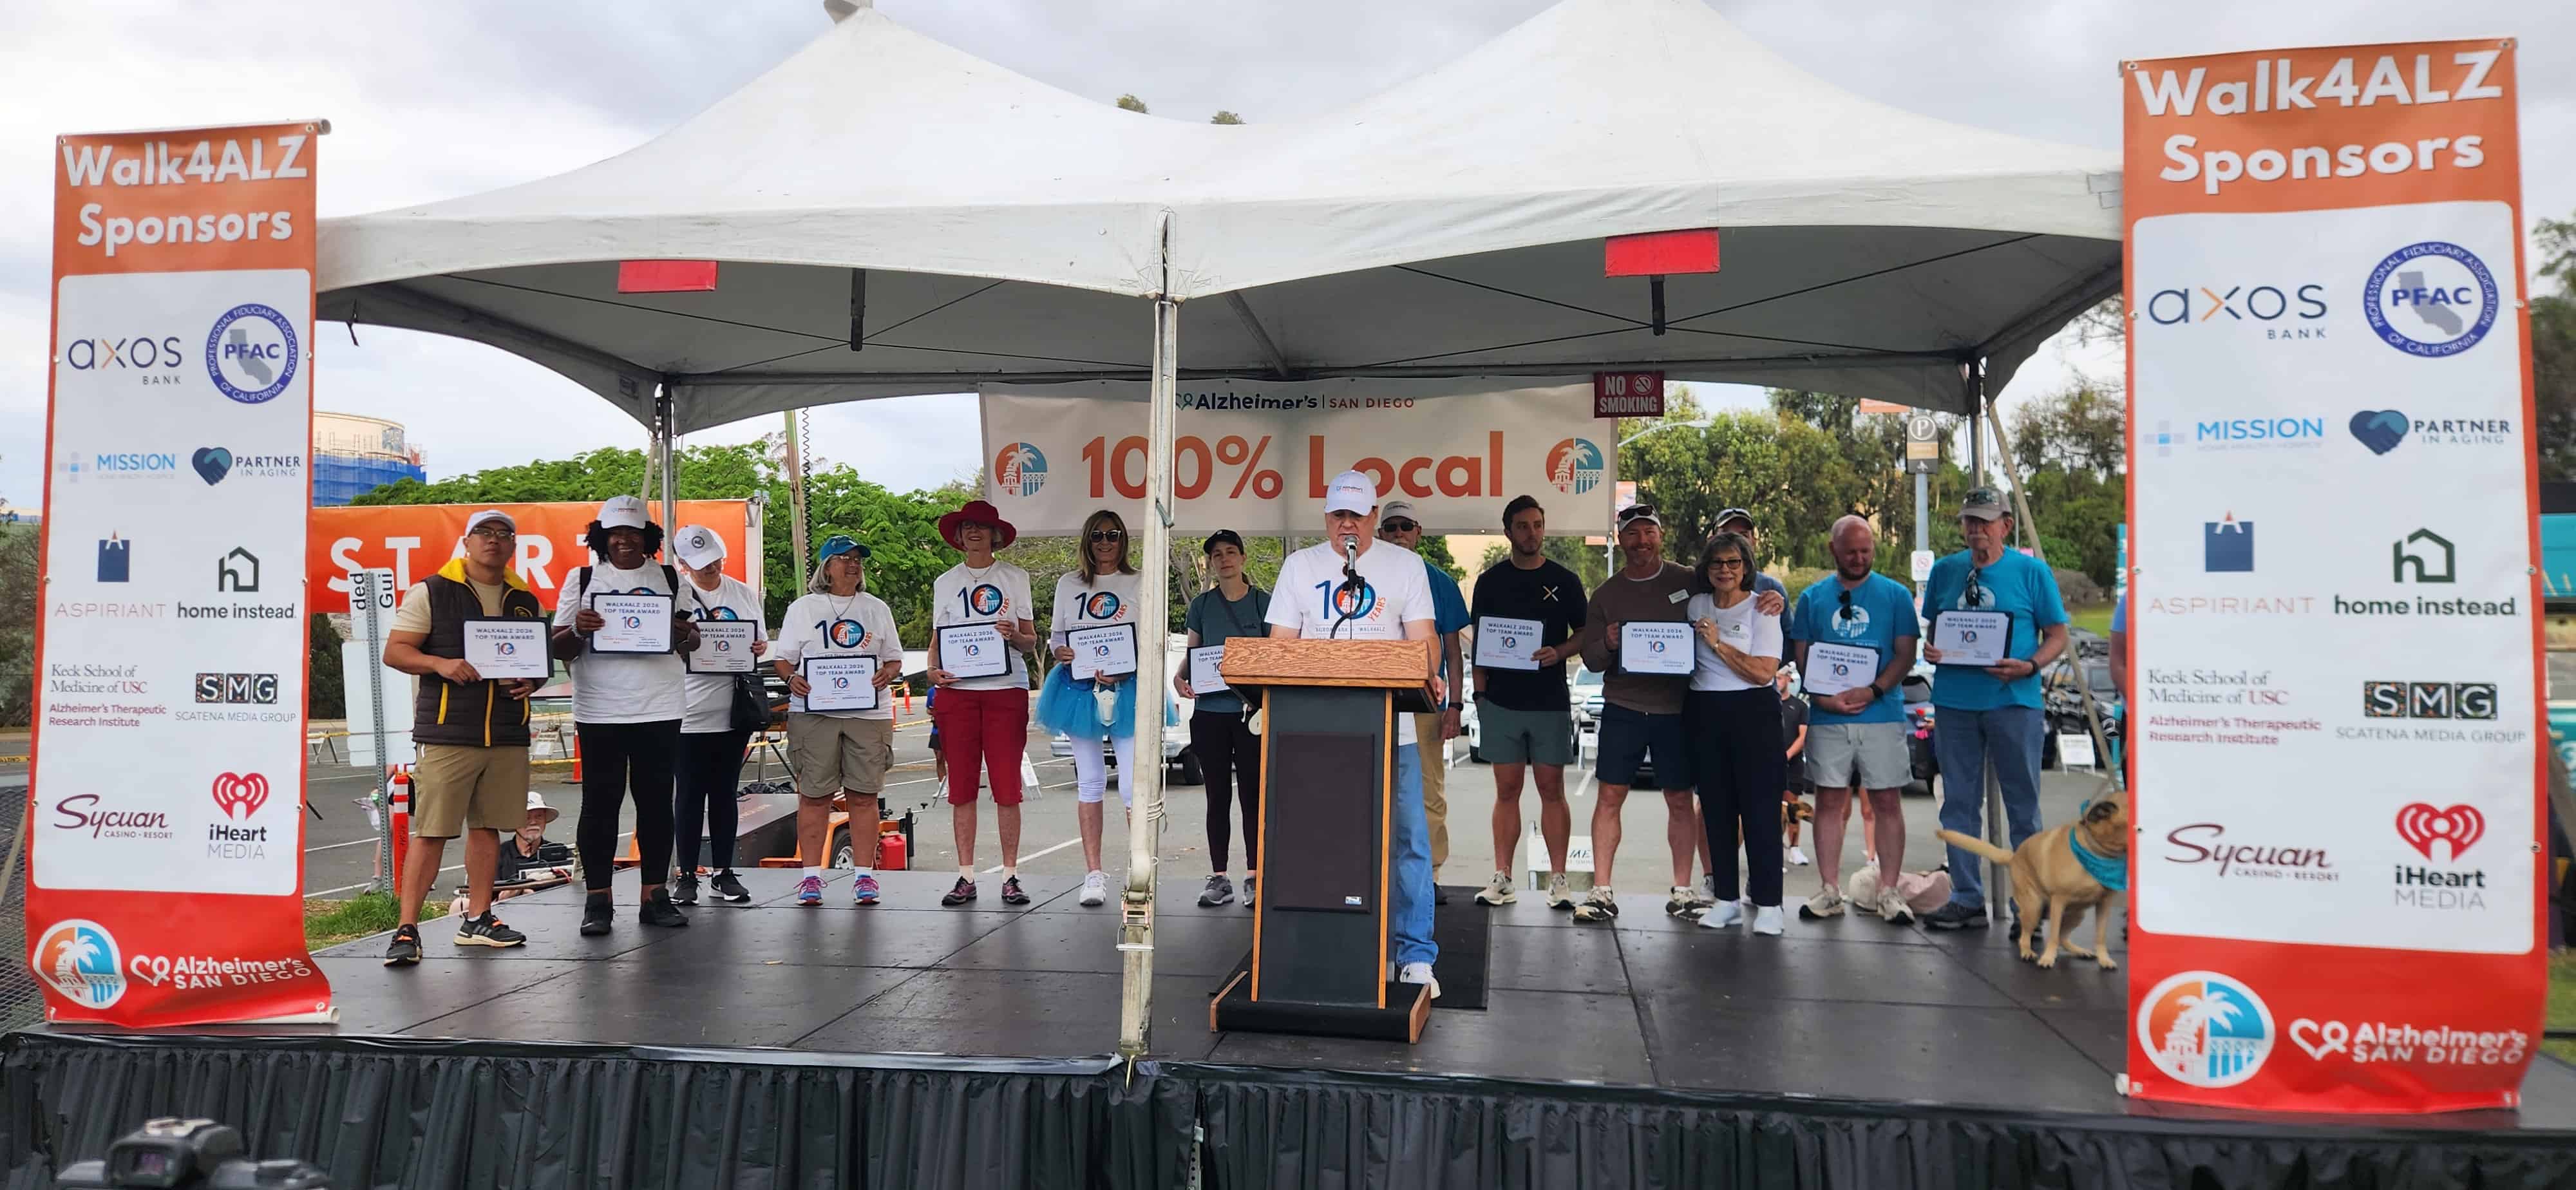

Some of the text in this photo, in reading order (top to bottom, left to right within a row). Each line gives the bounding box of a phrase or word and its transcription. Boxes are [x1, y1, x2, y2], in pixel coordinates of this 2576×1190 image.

[2135, 50, 2503, 116] Walk4ALZ
[63, 134, 308, 186] Walk4ALZ
[2159, 134, 2485, 195] Sponsors
[78, 203, 292, 257] Sponsors
[2148, 285, 2327, 325] axos
[2391, 287, 2472, 307] PFAC
[208, 306, 296, 377] PROFESSIONAL FIDUCIARY ASSOCIATION
[2268, 327, 2326, 339] BANK
[68, 336, 182, 370] axos
[225, 343, 280, 359] PFAC
[2388, 332, 2479, 355] OF CALIFORNIA
[142, 375, 181, 384] BANK
[1605, 375, 1626, 395] NO
[220, 381, 283, 401] OF CALIFORNIA
[1195, 393, 1414, 410] Alzheimer's SAN DIEGO
[1600, 396, 1657, 412] SMOKING
[2198, 417, 2323, 441] MISSION
[2414, 420, 2510, 434] PARTNER
[2422, 434, 2505, 444] IN AGING
[97, 453, 175, 471] MISSION
[236, 455, 300, 468] PARTNER
[1083, 430, 1503, 500] 100% Local
[260, 468, 296, 477] AGING
[956, 583, 1003, 618] 10
[998, 598, 1010, 616] YEARS
[1074, 591, 1121, 620] 10
[1315, 580, 1376, 619] 10
[1367, 597, 1387, 621] YEARS
[2148, 596, 2316, 615] ASPIRIANT
[2334, 595, 2409, 616] home
[55, 603, 166, 618] ASPIRIANT
[178, 601, 228, 619] home
[1112, 603, 1128, 623] YEARS
[814, 619, 865, 649] 10
[860, 631, 873, 650] YEARS
[52, 664, 138, 678] Keck School of
[2148, 669, 2271, 685] Keck School of
[50, 681, 147, 694] Medicine of USC
[198, 674, 277, 703] SMG
[2148, 688, 2289, 706] Medicine of USC
[50, 704, 166, 716] Alzheimer's Therapeutic
[2367, 683, 2496, 719] SMG
[49, 717, 140, 727] Research Institute
[175, 712, 296, 722] SCATENA MEDIA GROUP
[2233, 717, 2322, 732] Therapeutic
[2148, 732, 2279, 746] Research Institute
[2335, 727, 2527, 744] SCATENA MEDIA GROUP
[54, 794, 169, 838] Sycuan
[209, 824, 267, 842] iHeart
[207, 844, 265, 860] MEDIA
[2165, 824, 2332, 876] Sycuan
[2395, 865, 2486, 888] iHeart
[2395, 889, 2486, 910] MEDIA
[173, 956, 304, 974] Alzheimer's
[174, 967, 311, 989] SAN DIEGO
[2354, 1023, 2528, 1049] Alzheimer's
[2352, 1045, 2523, 1065] SAN DIEGO
